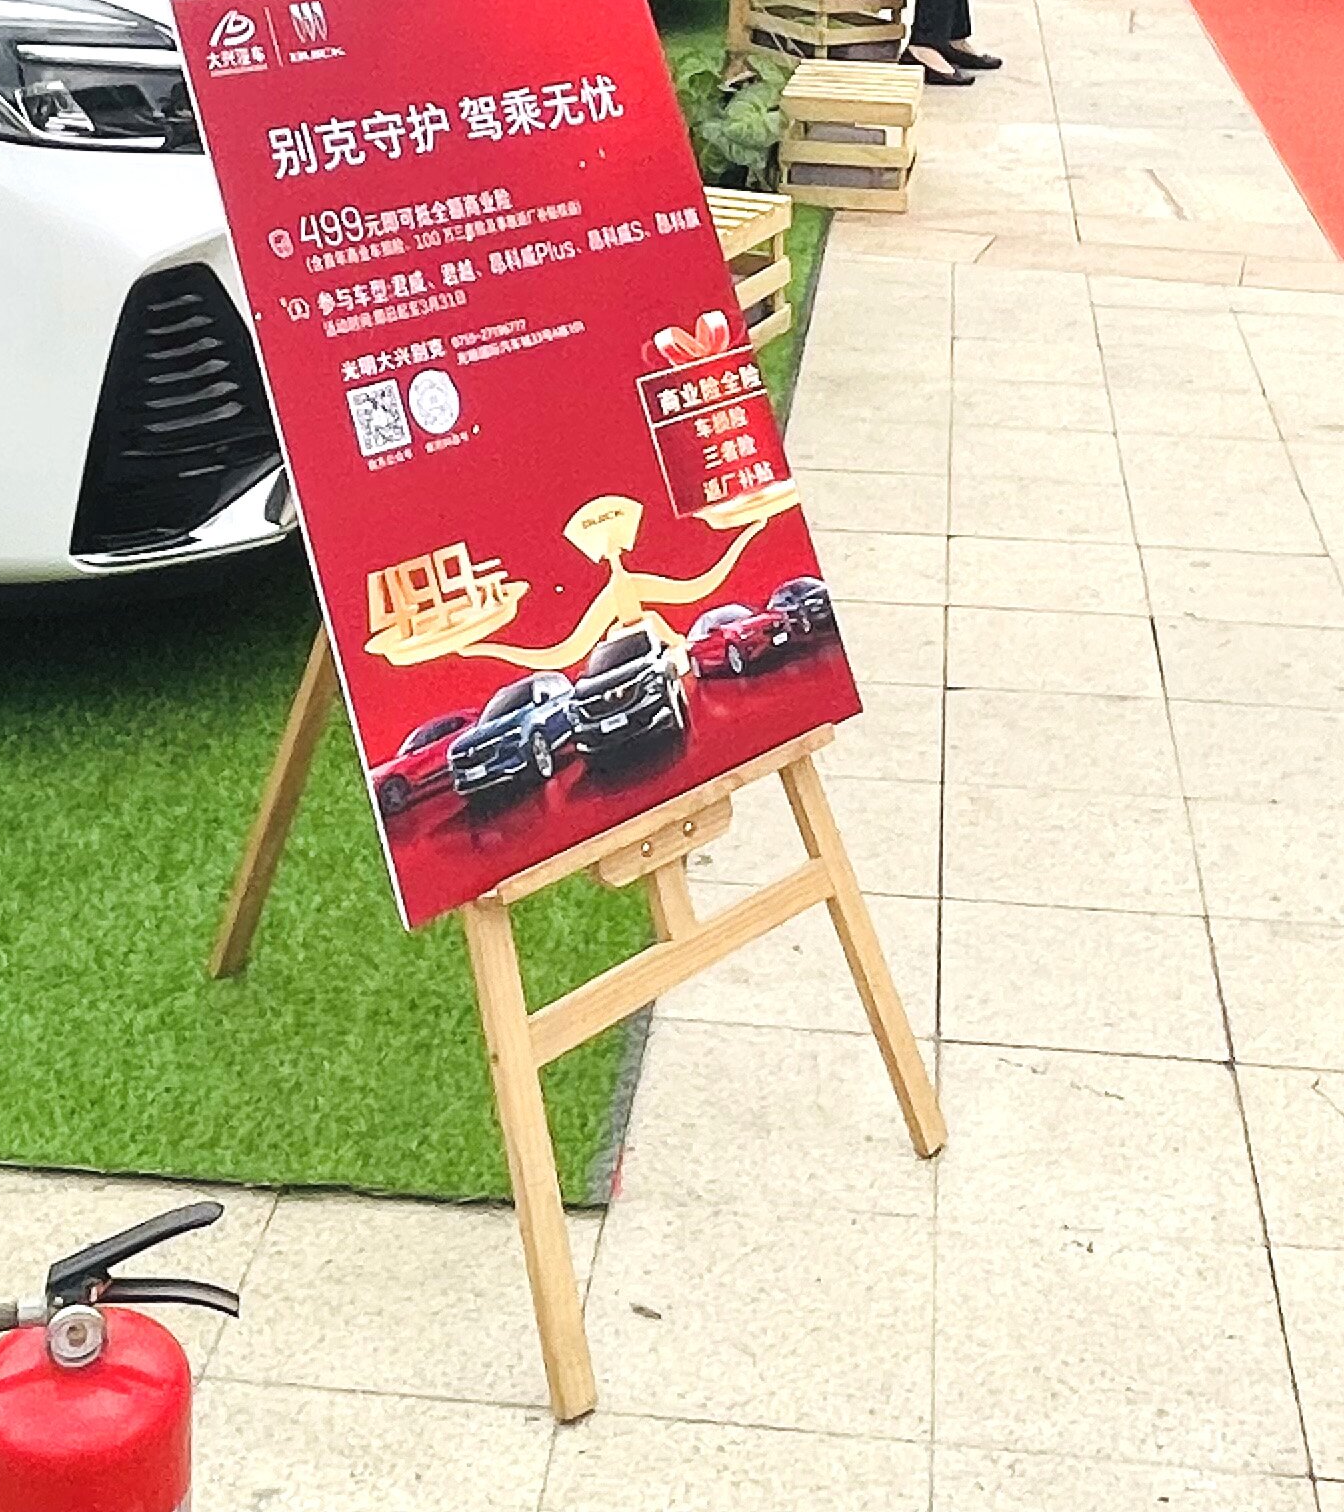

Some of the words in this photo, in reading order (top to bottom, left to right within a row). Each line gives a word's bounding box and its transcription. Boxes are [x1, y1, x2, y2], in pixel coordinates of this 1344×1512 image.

[289, 46, 346, 63] BUICK
[267, 102, 451, 180] 别克守护
[458, 74, 624, 141] 驾乘无忧
[340, 338, 446, 382] 光明大兴别克
[657, 363, 763, 416] 商业险全险
[367, 540, 510, 638] 499元
